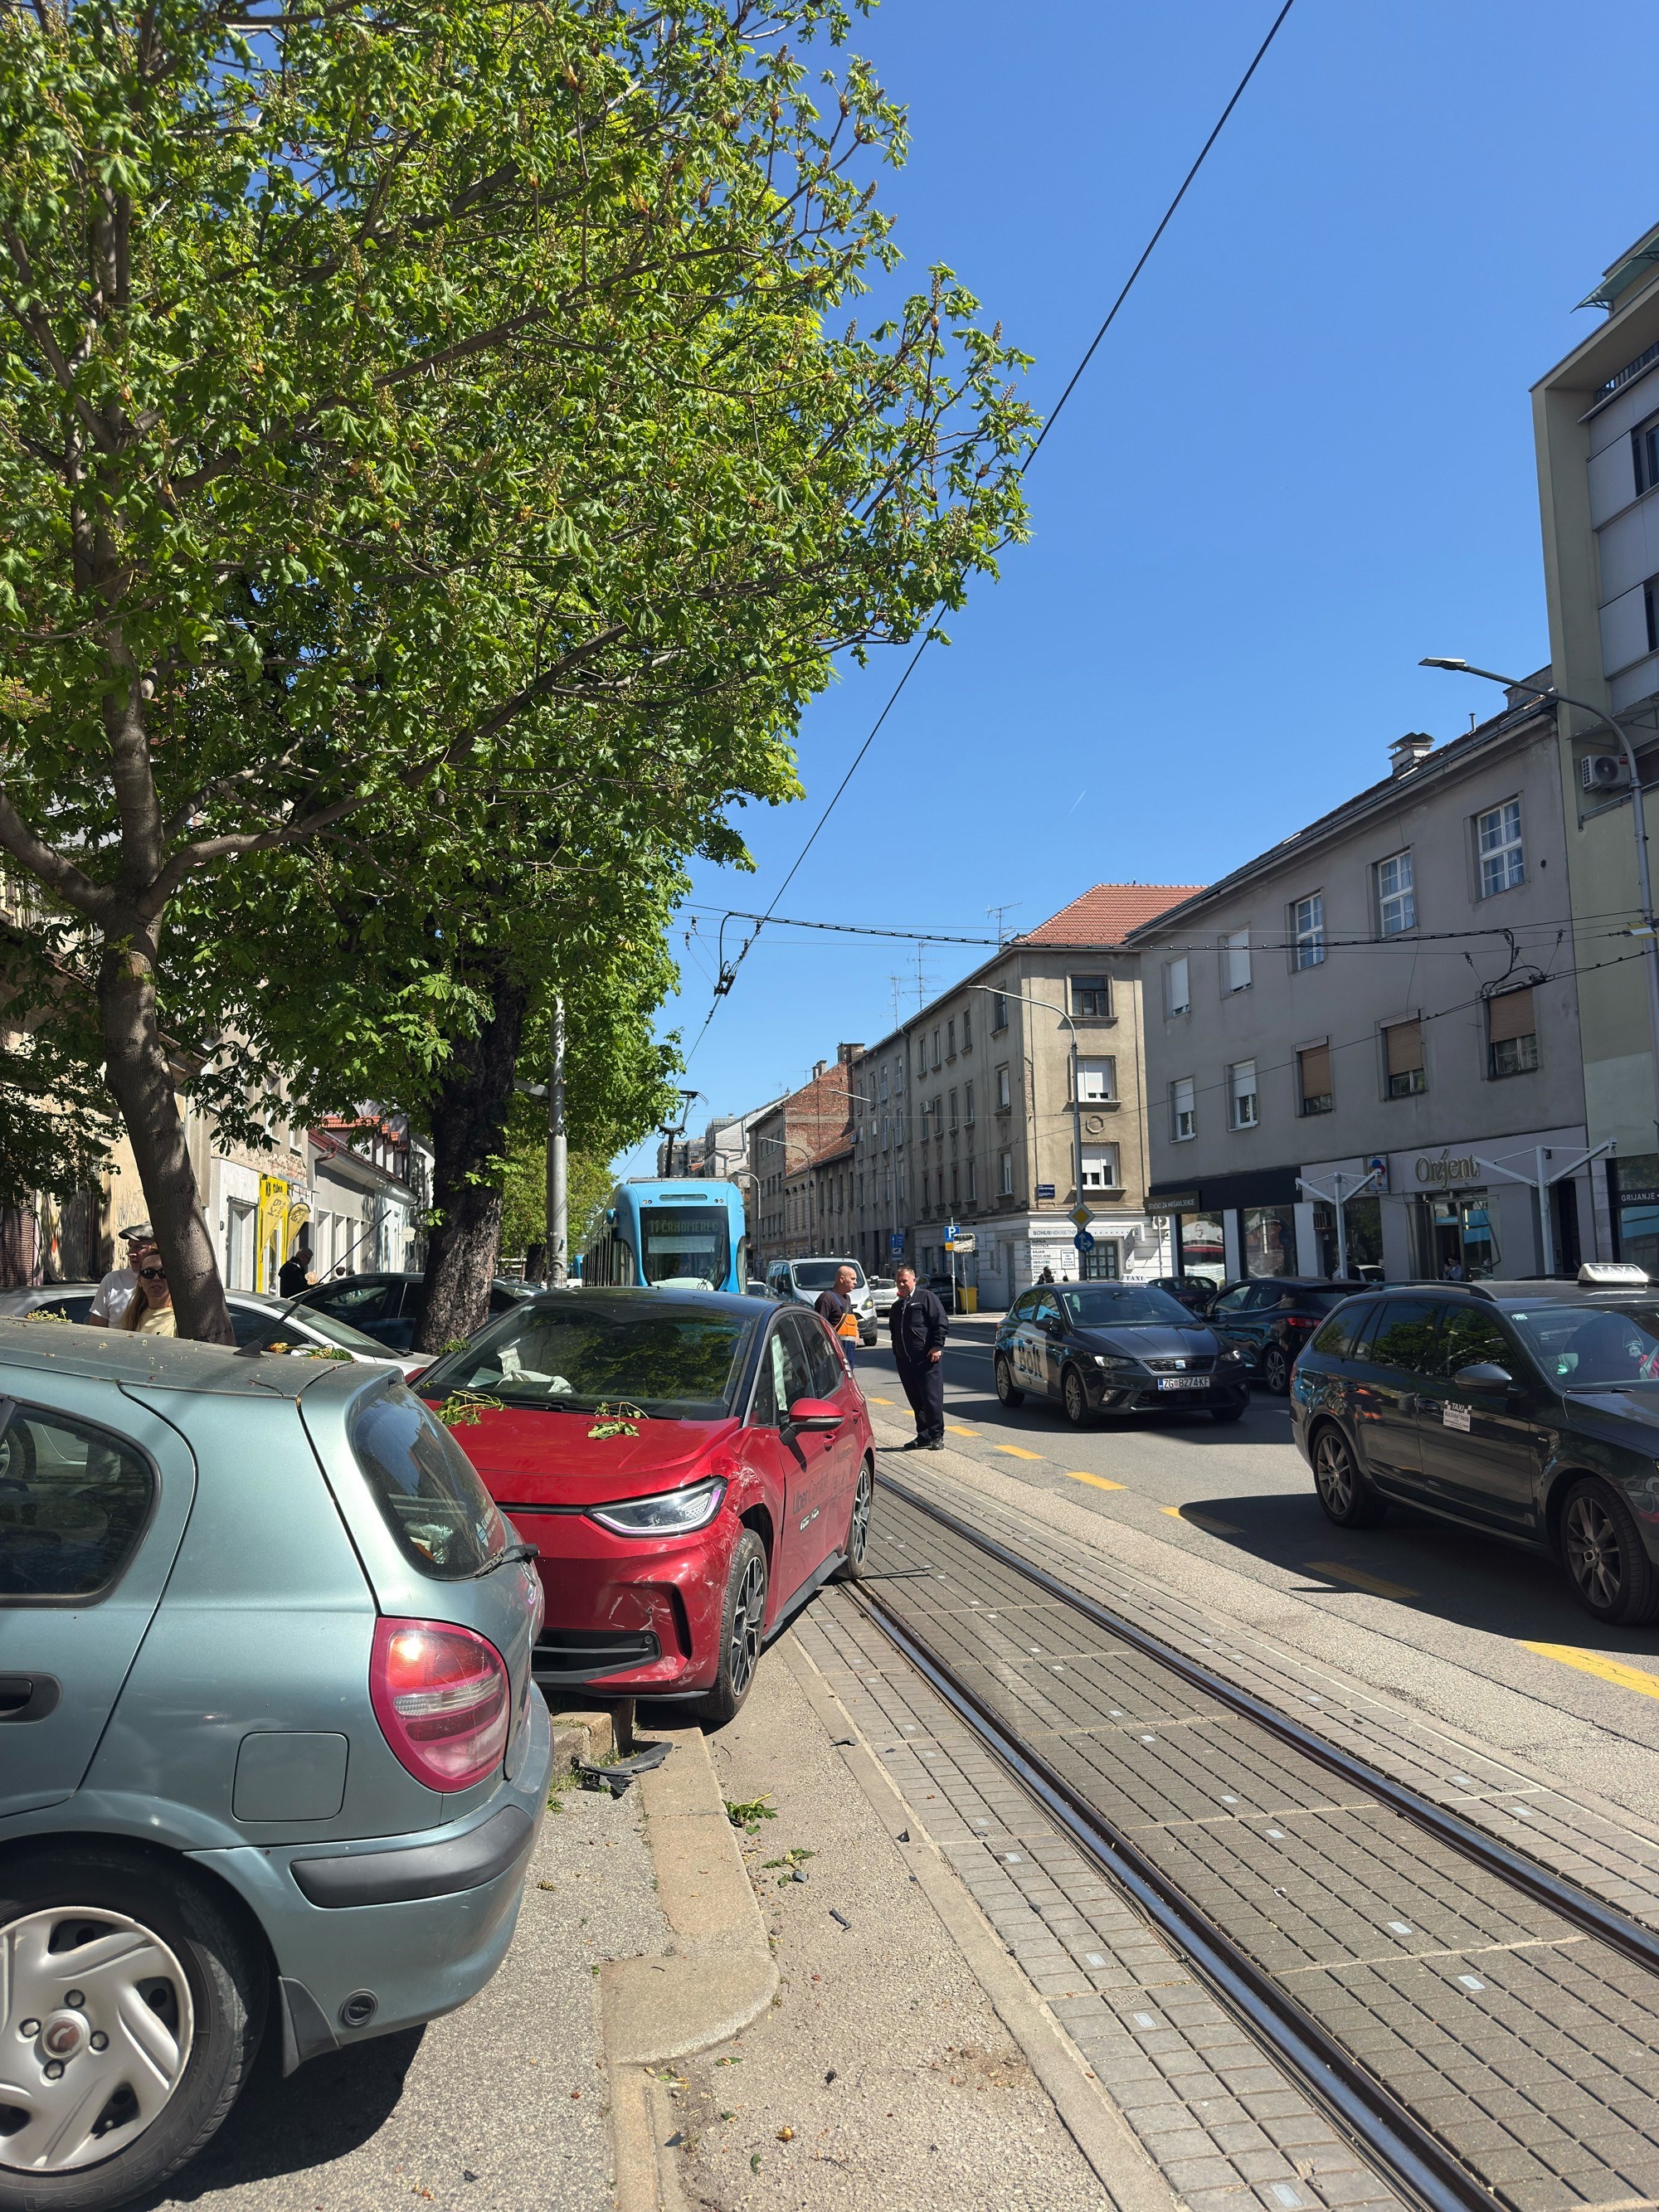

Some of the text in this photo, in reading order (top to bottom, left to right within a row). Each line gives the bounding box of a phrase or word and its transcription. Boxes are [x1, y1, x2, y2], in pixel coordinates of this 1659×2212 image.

[1621, 1192, 1656, 1202] GRIJANJE
[267, 1198, 282, 1217] K9
[275, 1202, 286, 1218] SHOP
[948, 1227, 956, 1238] P
[1594, 1266, 1636, 1276] TAXI
[1019, 1339, 1043, 1378] Bolt
[1164, 1379, 1174, 1388] ZG
[1452, 1403, 1465, 1412] TAXI
[793, 1490, 808, 1515] Uber
